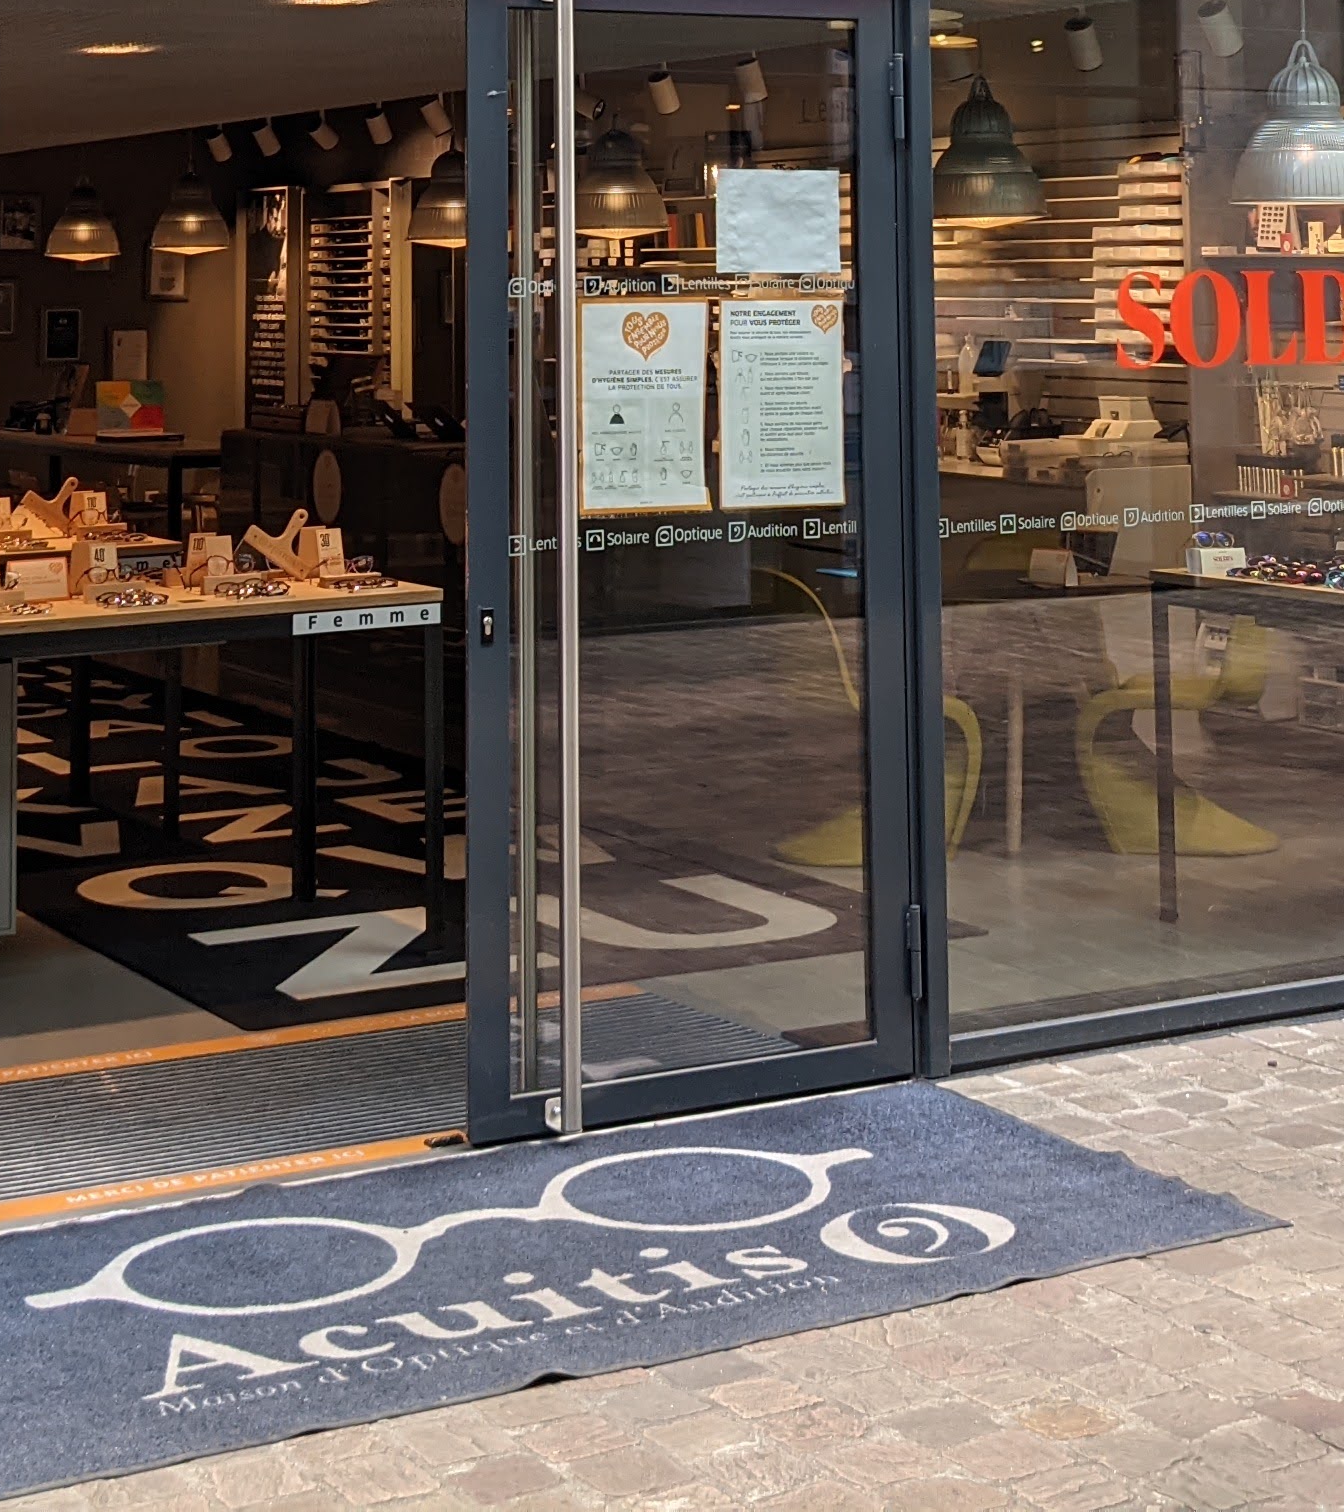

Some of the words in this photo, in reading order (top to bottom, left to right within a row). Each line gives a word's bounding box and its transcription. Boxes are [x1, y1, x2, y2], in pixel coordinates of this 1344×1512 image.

[604, 278, 657, 293] Audition
[816, 275, 856, 291] Optiqu
[609, 368, 640, 376] PARTAGER
[642, 368, 654, 376] DES
[655, 368, 682, 376] MESURES
[617, 383, 655, 391] PROTECTION
[950, 518, 997, 535] Lentilles
[1018, 515, 1056, 531] Solaire
[1077, 512, 1119, 528] Optique
[1140, 508, 1185, 524] Audition
[1205, 503, 1248, 519] Lentilles
[1267, 500, 1302, 516] Solaire
[606, 531, 650, 547] Solaire
[674, 527, 723, 544] Optique
[746, 522, 799, 538] Audition
[65, 1183, 145, 1205] MERCI
[152, 1174, 187, 1189] DE
[193, 1155, 322, 1184] PATIENTER
[330, 1148, 366, 1163] ICI
[142, 1244, 809, 1401] Acuitis
[158, 1378, 302, 1418] Maison
[318, 1327, 549, 1386] d'Optique
[564, 1320, 605, 1337] et
[617, 1273, 840, 1327] d'Audition
